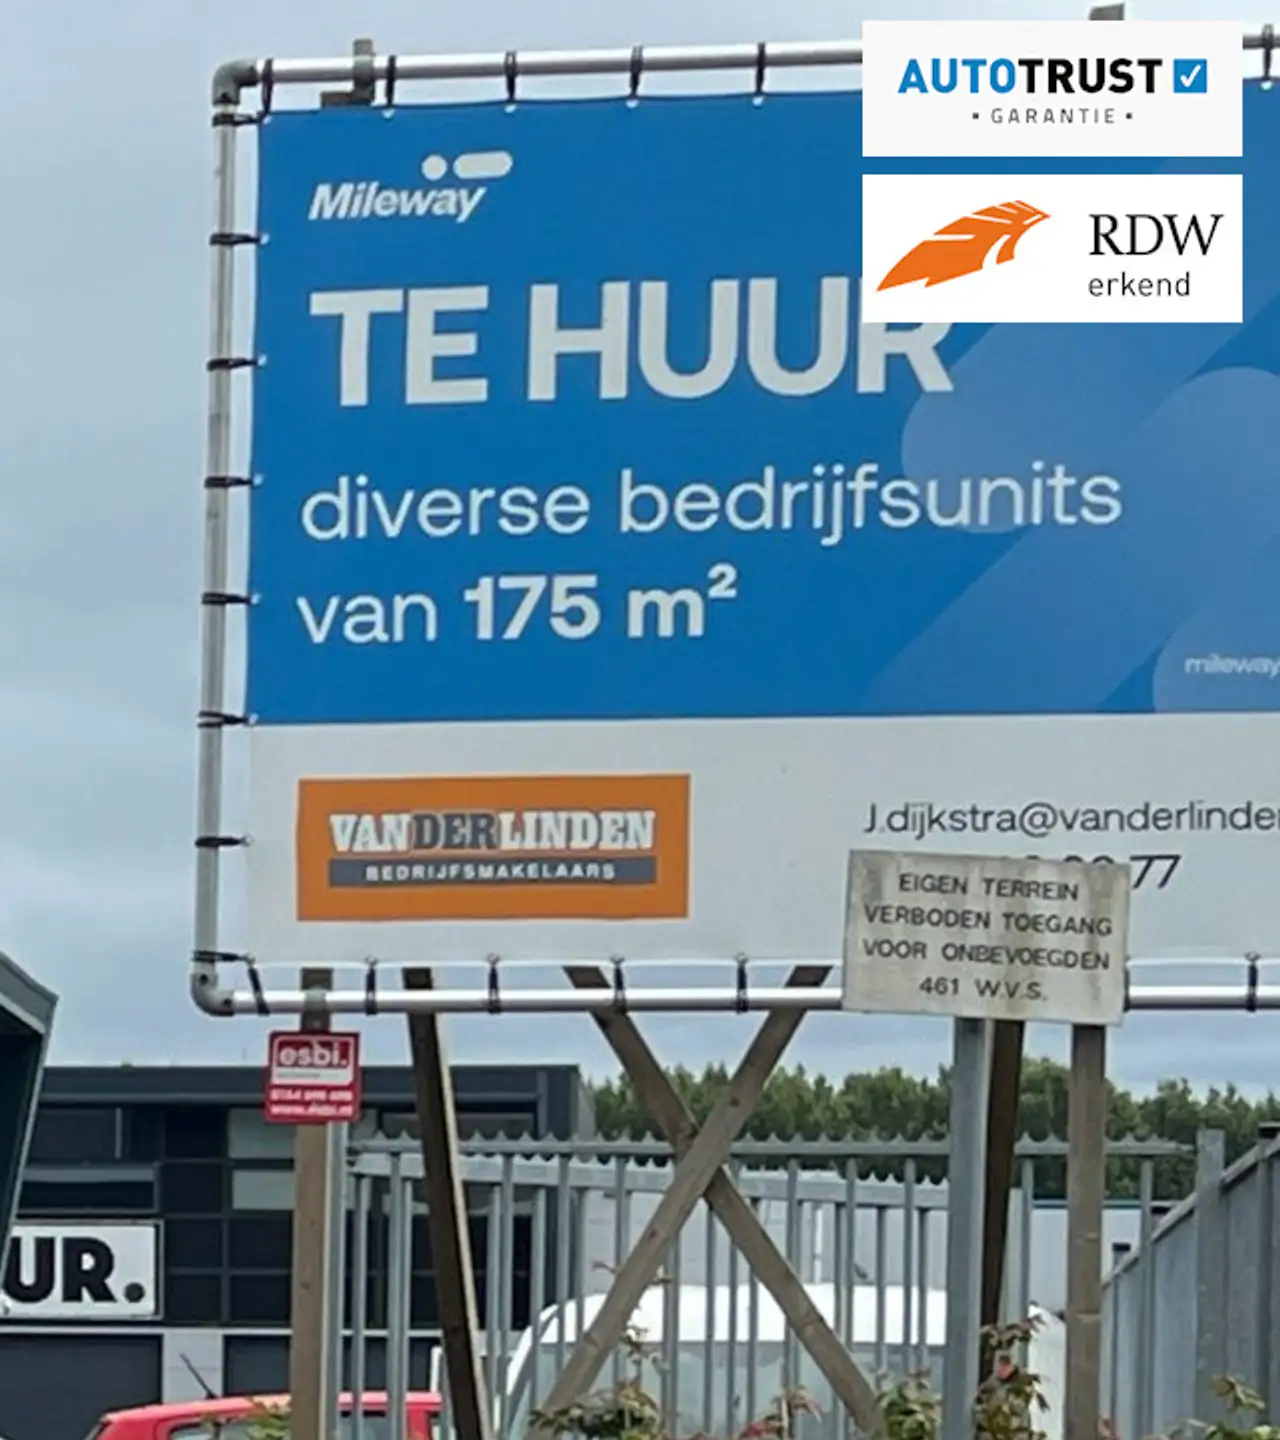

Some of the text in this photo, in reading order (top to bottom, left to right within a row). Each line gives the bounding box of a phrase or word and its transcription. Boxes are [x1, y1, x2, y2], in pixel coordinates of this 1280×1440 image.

[308, 181, 488, 223] Mileway
[309, 285, 489, 407] TE
[301, 460, 1123, 547] diverse bedrijfsunits
[296, 592, 438, 645] van
[463, 574, 602, 640] 175
[863, 799, 1280, 841] J.dijkstra@vanderlinde
[365, 862, 616, 882] BEDRIJFSMAKELAARS
[898, 872, 1079, 900] EIGEN TERREIN
[864, 904, 1113, 936] VERBODEN TOEGANG
[862, 939, 1111, 970] VOOR ONBEVOEGDEN
[918, 976, 960, 996] 461
